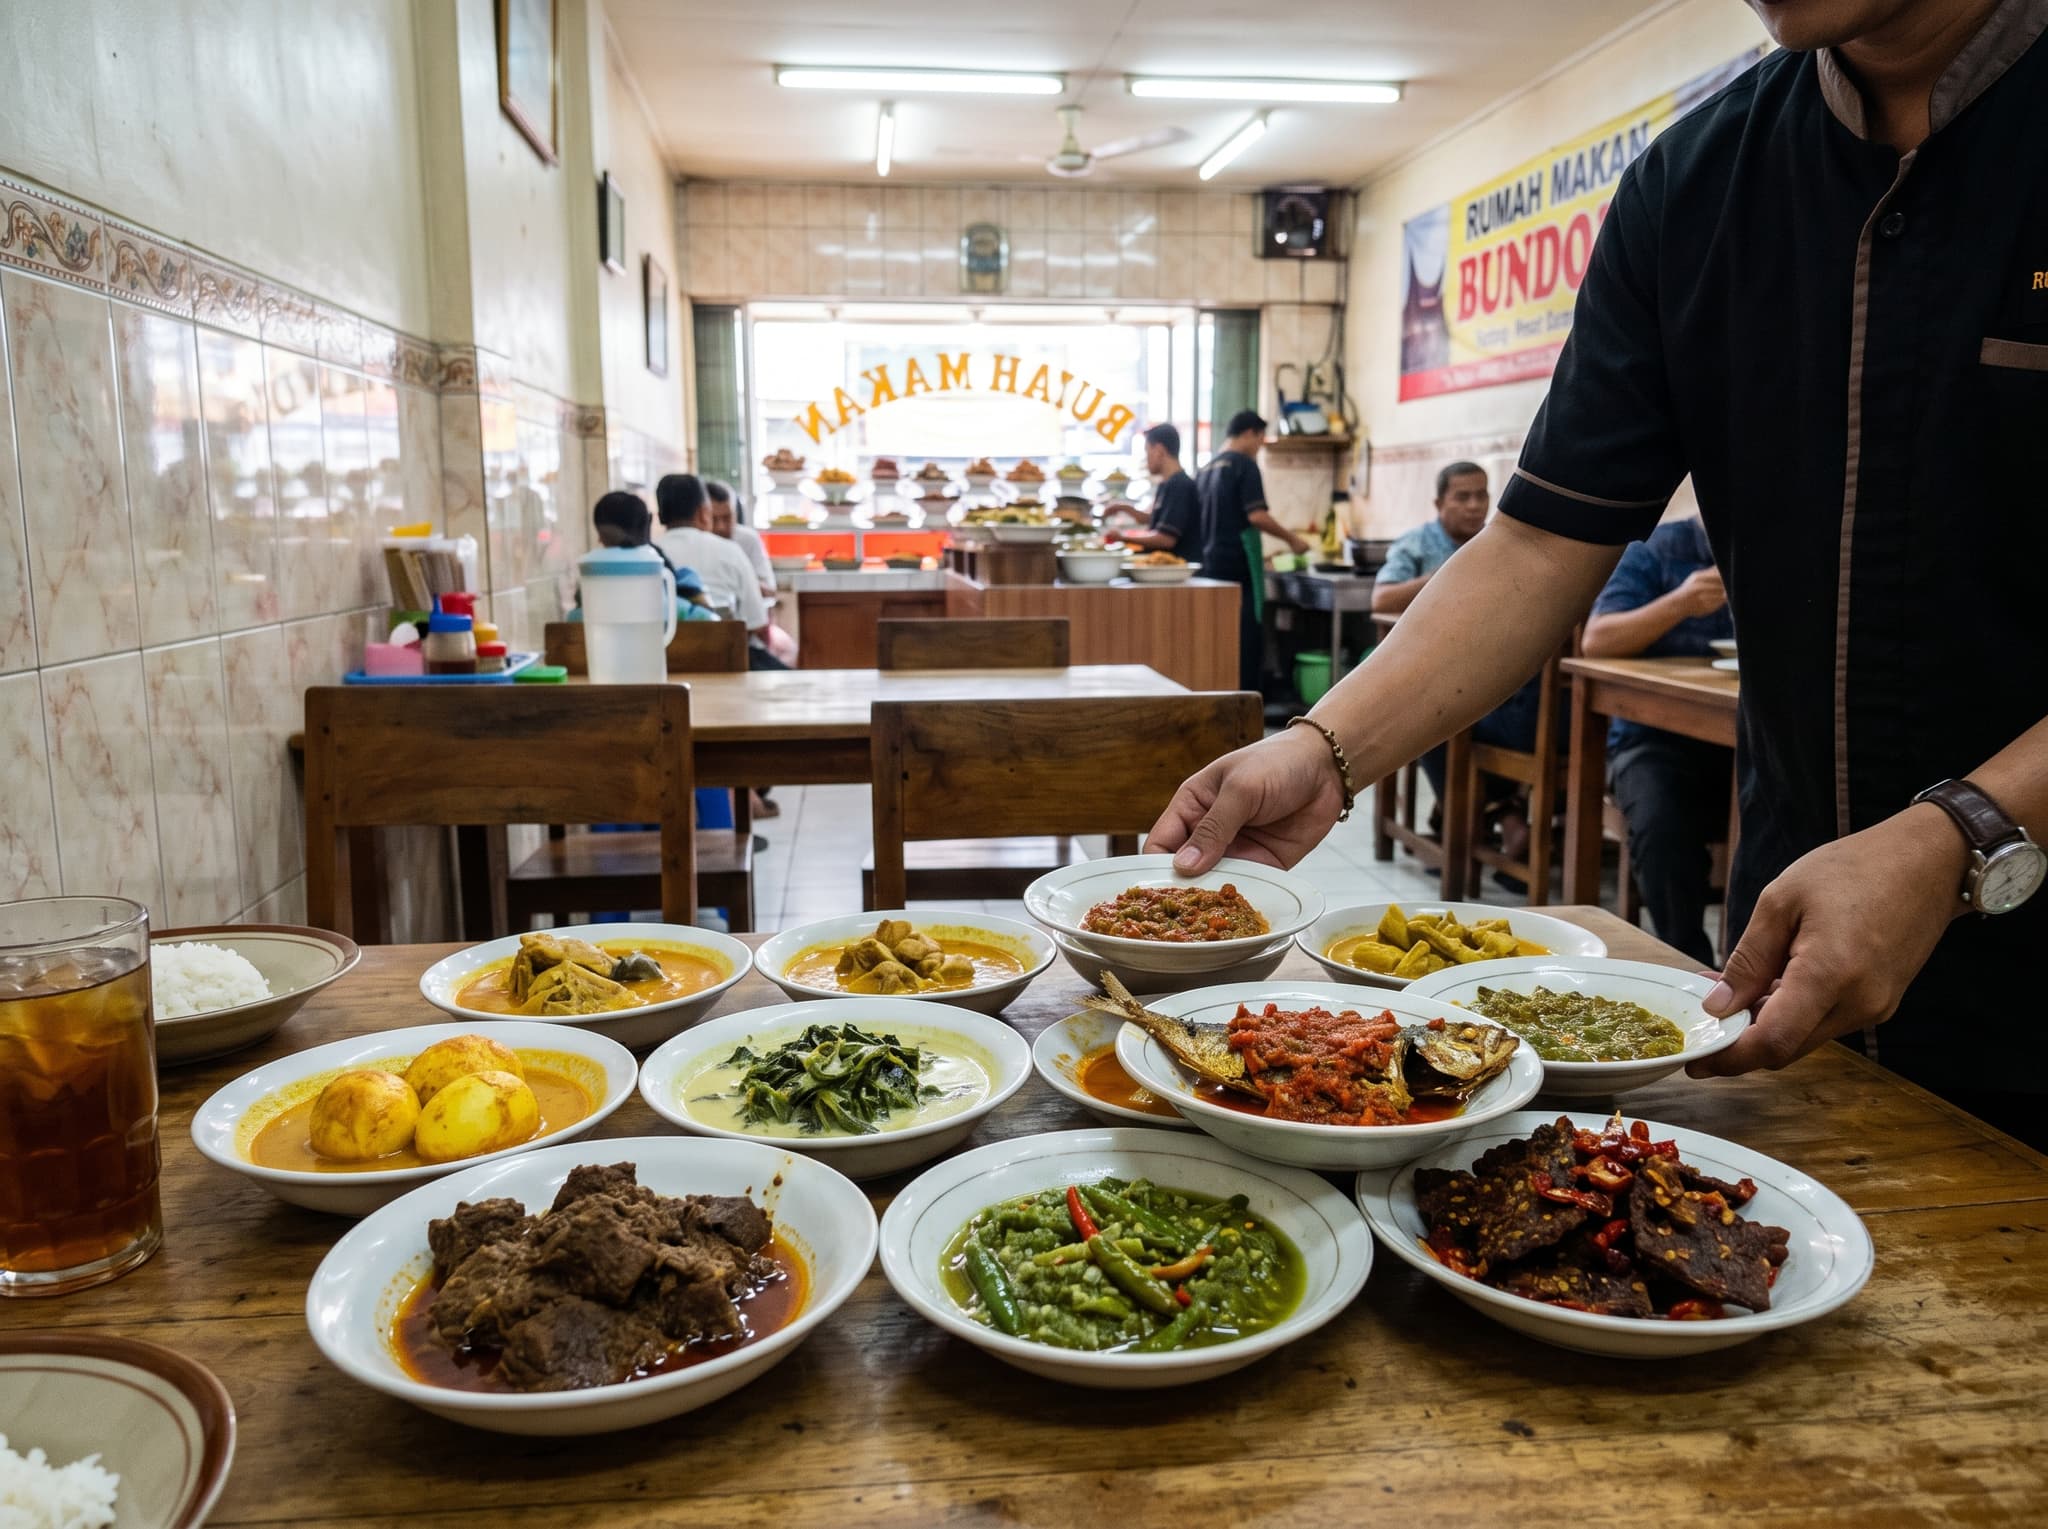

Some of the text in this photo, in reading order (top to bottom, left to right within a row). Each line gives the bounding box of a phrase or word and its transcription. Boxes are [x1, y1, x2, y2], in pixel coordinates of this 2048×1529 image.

[1465, 120, 1649, 242] RUMAH MAKAN
[1457, 203, 1610, 323] BUNDO
